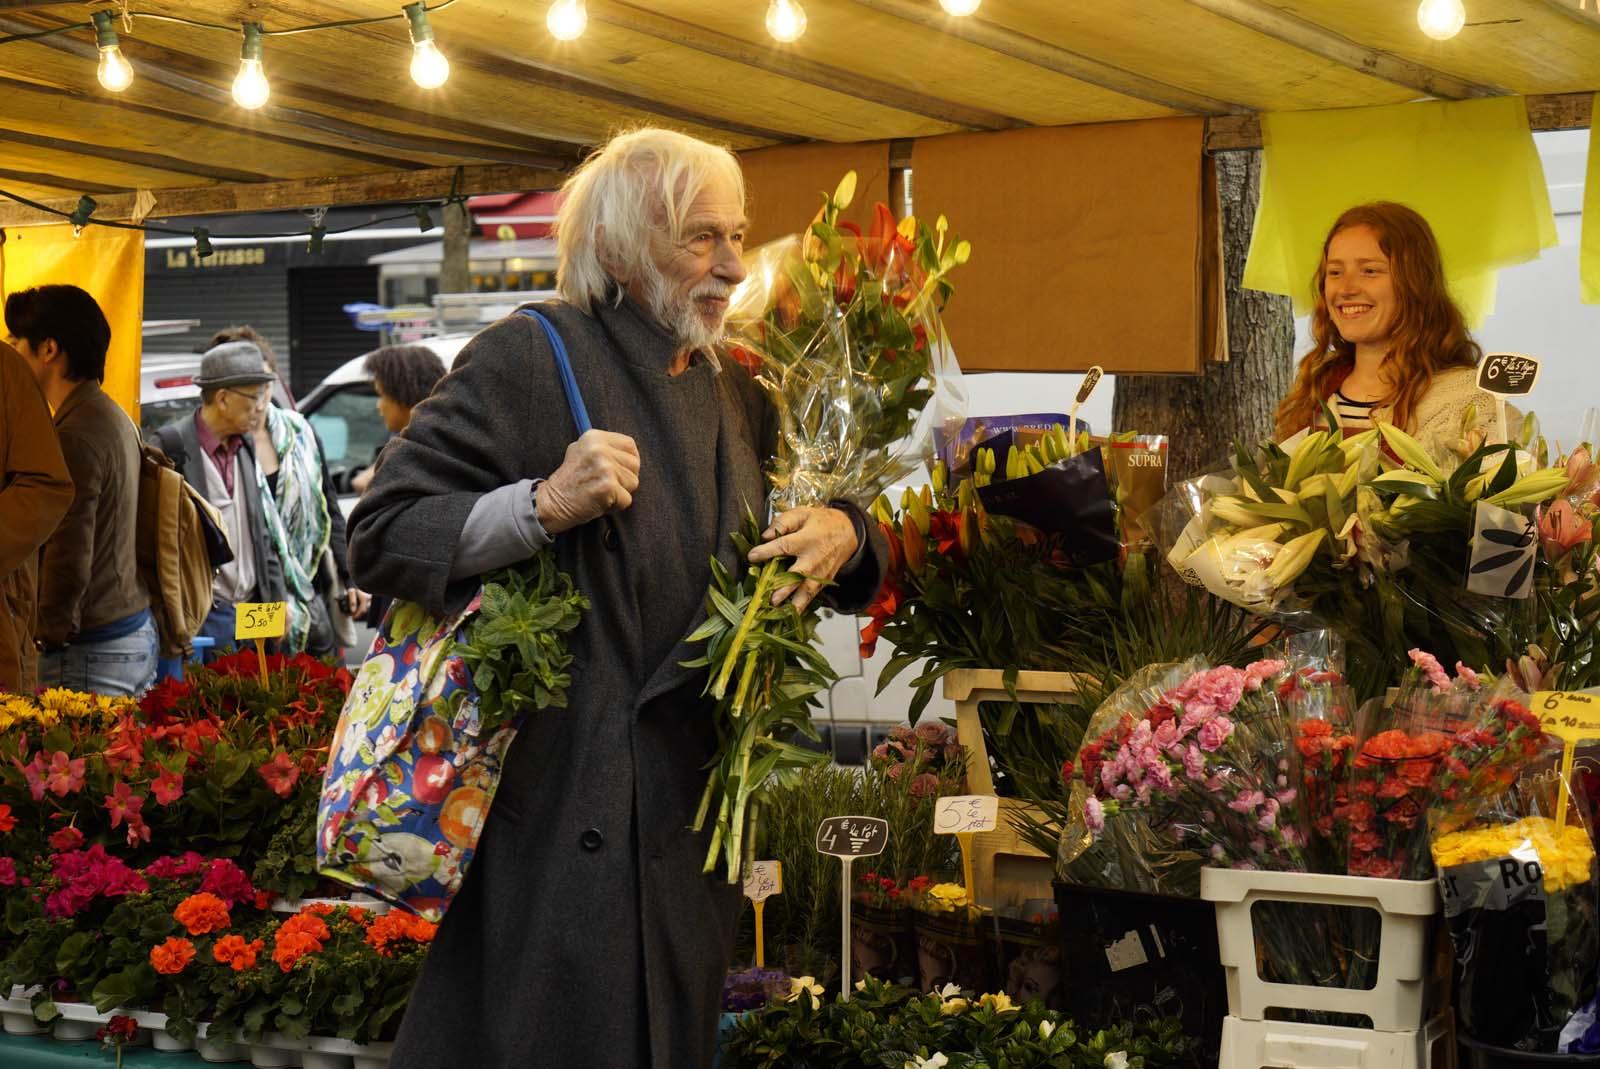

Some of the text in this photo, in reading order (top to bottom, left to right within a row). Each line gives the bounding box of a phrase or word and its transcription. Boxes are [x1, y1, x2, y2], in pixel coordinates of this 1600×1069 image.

[166, 247, 188, 269] La
[1128, 454, 1163, 467] SUPRA
[1544, 692, 1564, 709] 6
[1560, 716, 1578, 727] 10
